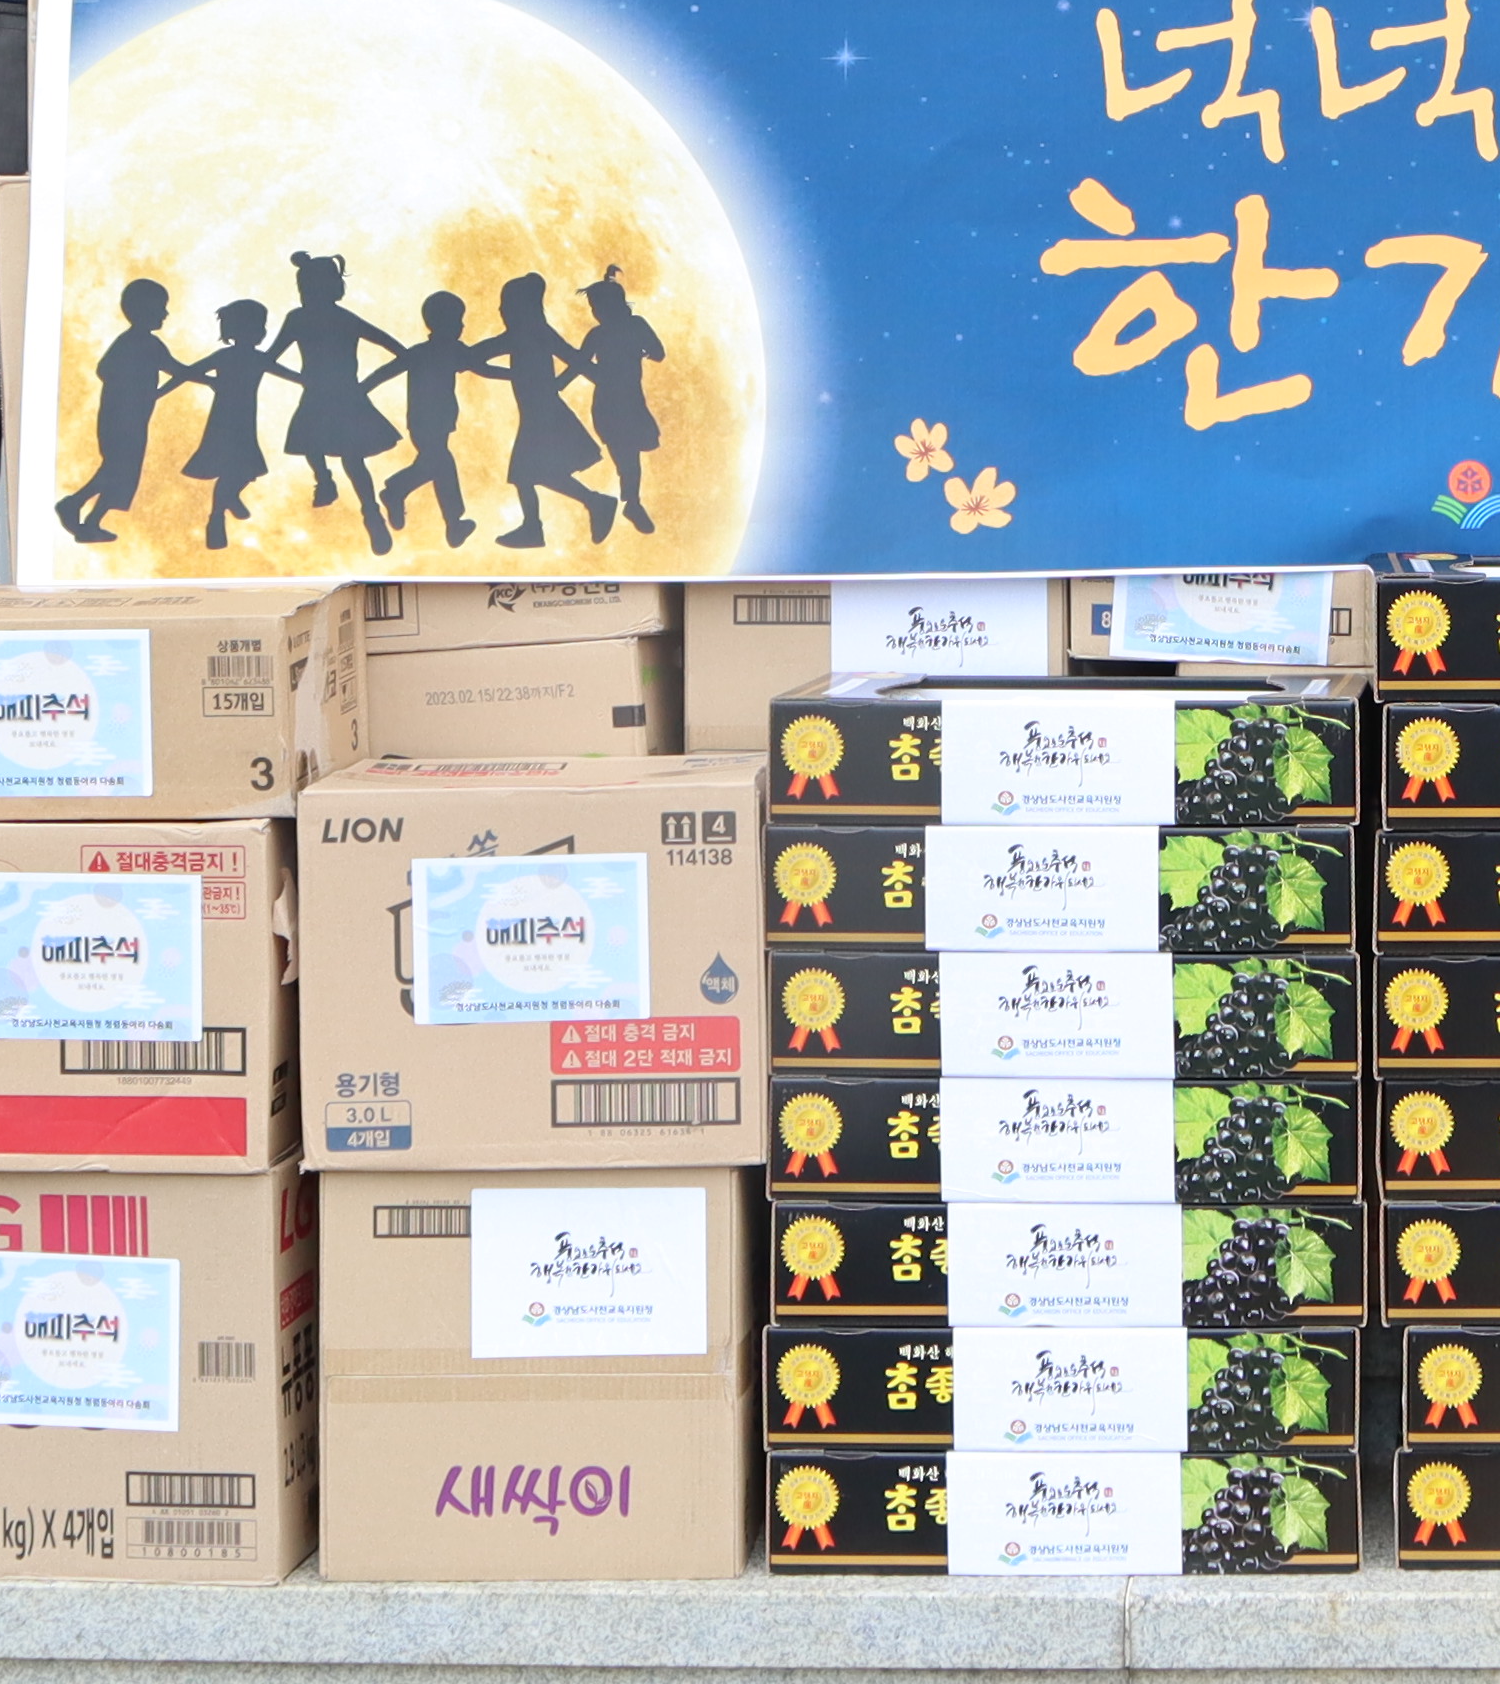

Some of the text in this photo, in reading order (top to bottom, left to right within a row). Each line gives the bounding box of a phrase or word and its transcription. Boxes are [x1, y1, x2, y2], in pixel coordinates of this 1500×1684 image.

[213, 692, 264, 712] 15개입
[250, 757, 275, 791] 3
[321, 817, 404, 843] LION
[711, 815, 726, 834] 4
[116, 851, 224, 872] 절대충격금지
[666, 849, 733, 866] 114138
[706, 976, 735, 993] 액체
[584, 1022, 696, 1043] 절대 충격 금지
[584, 1047, 732, 1068] 절대 2단 적재 금지
[335, 1072, 399, 1098] 용기형
[346, 1107, 375, 1123] 3.0
[346, 1129, 391, 1148] 4개입
[434, 1464, 631, 1536] 새싹이
[63, 1507, 114, 1559] 4개입
